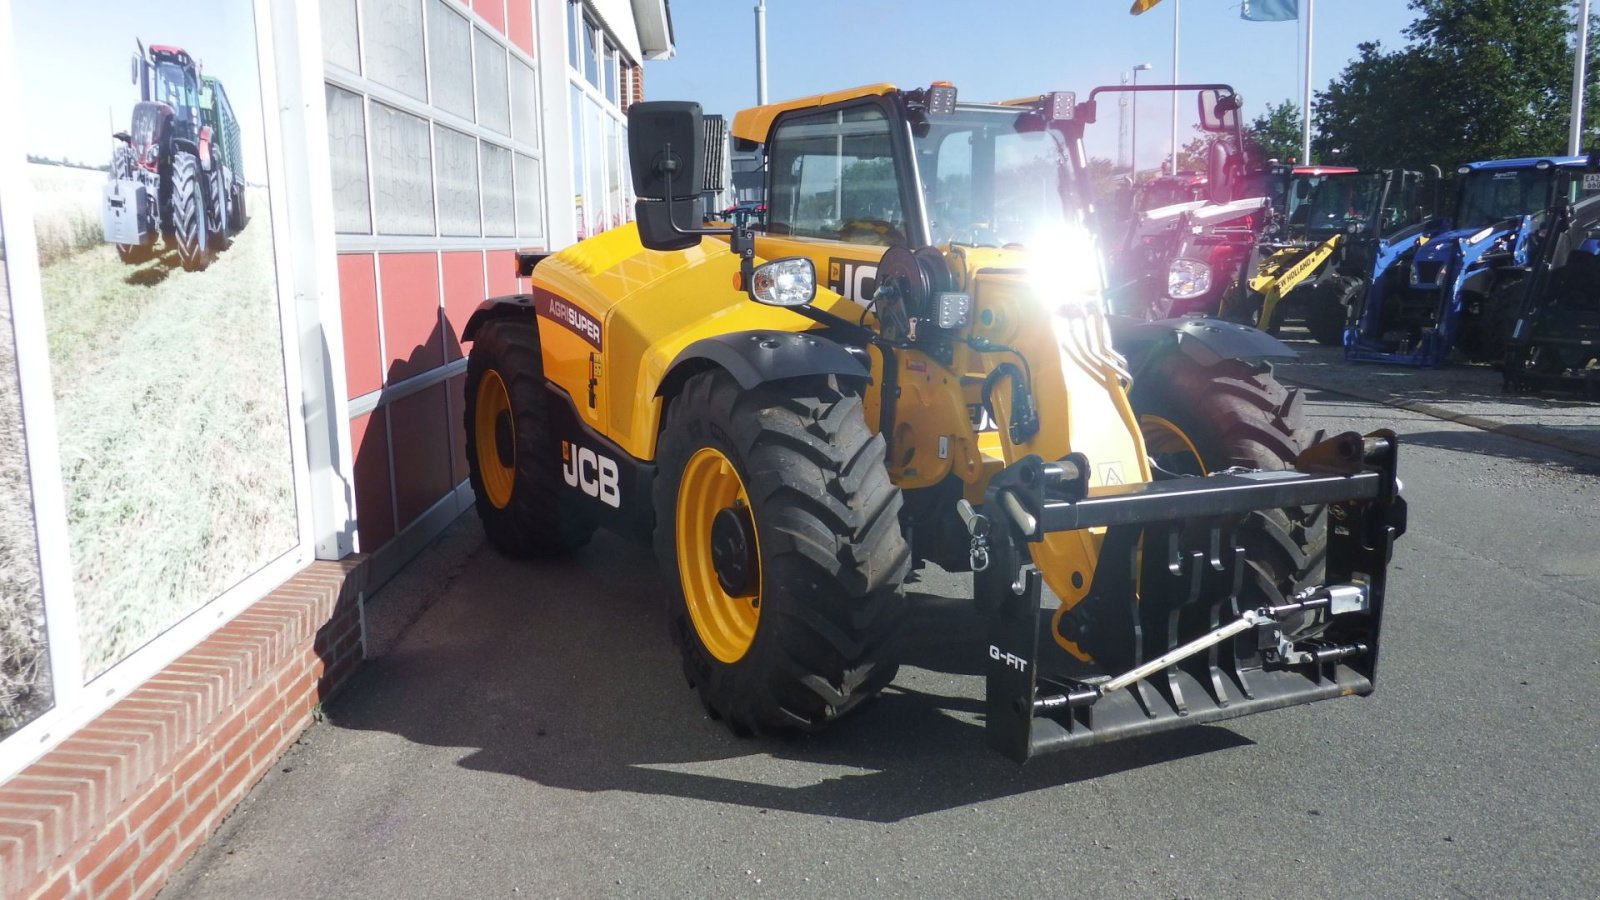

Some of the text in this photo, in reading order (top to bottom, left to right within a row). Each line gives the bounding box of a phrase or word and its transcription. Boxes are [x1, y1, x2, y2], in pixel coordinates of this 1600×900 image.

[830, 263, 878, 312] JC
[1286, 258, 1311, 283] HOLLAND
[562, 441, 620, 508] JCB
[989, 644, 1028, 672] Q-FIT
